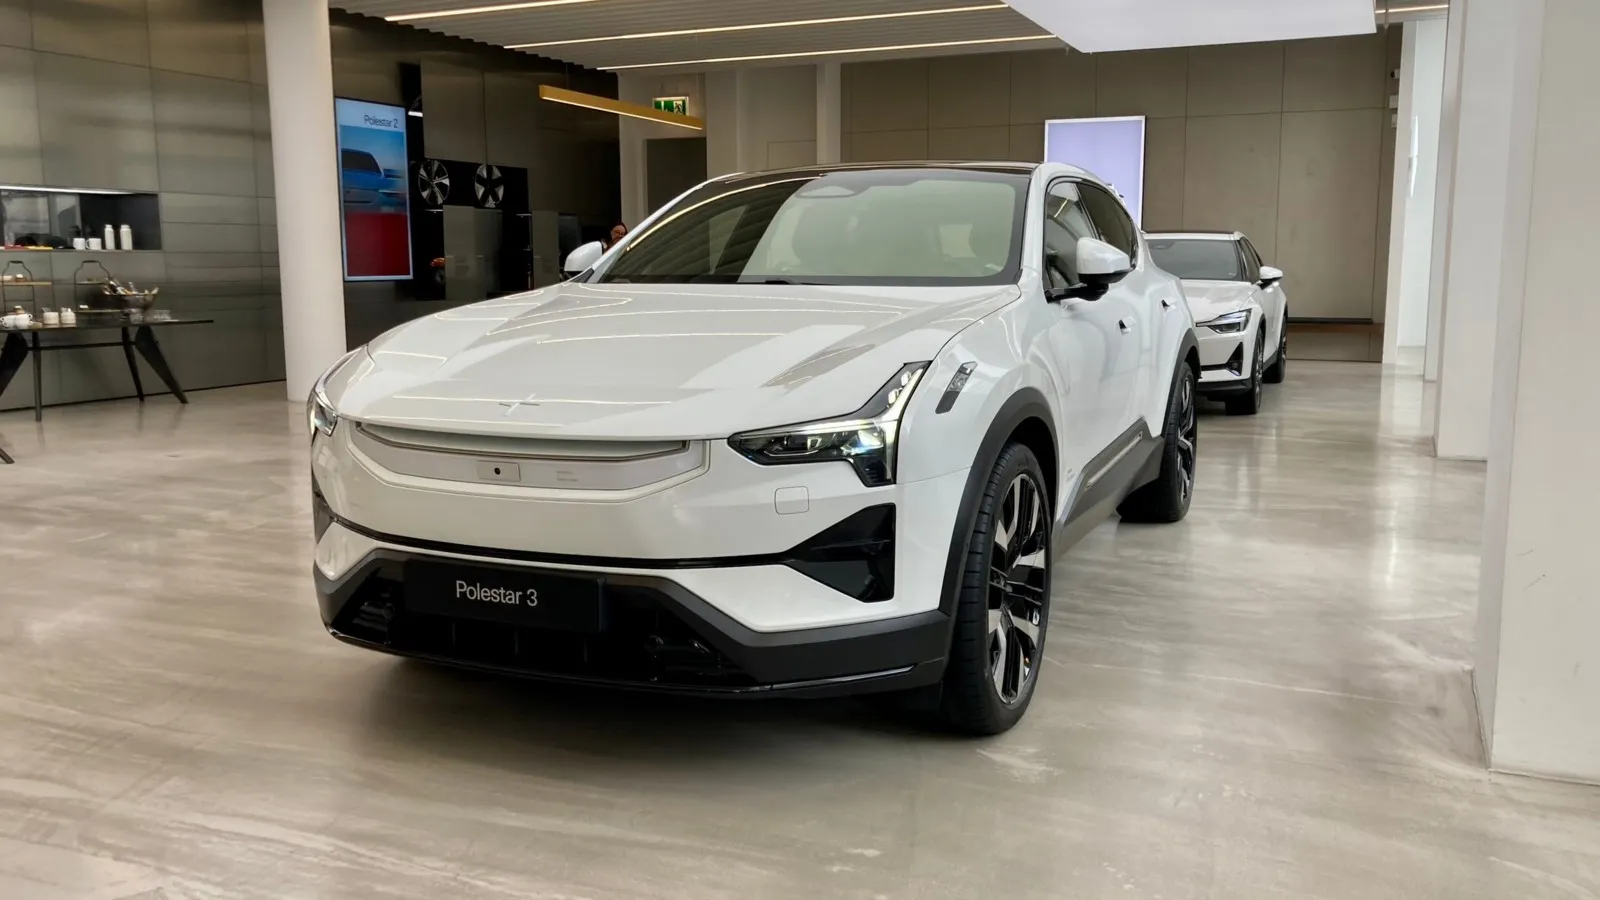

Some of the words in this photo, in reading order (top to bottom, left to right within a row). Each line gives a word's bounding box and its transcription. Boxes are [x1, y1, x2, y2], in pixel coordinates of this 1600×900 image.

[364, 114, 392, 127] Polestar
[393, 118, 399, 129] 2
[456, 580, 522, 605] Polestar
[526, 588, 538, 607] 3
